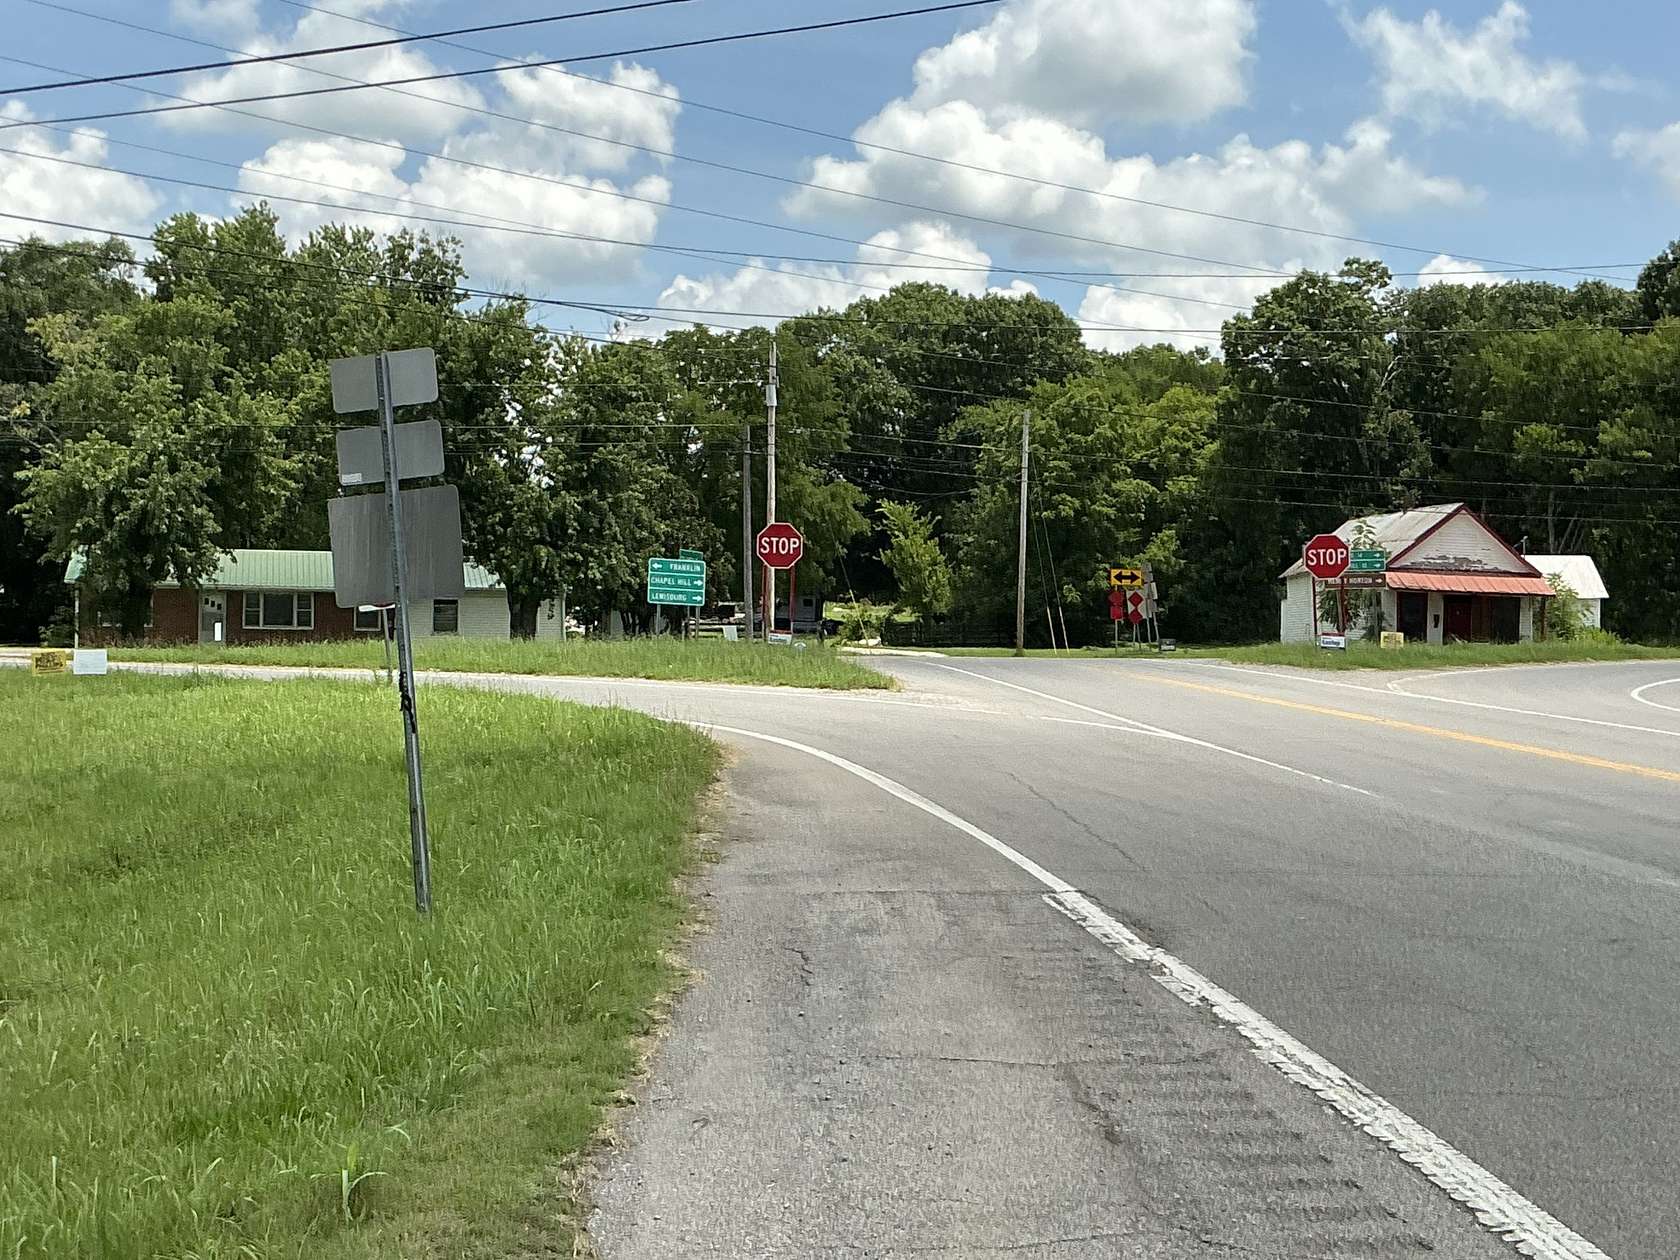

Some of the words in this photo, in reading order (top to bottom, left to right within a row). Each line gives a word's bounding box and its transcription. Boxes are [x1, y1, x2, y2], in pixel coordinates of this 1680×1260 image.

[760, 537, 800, 554] STOP
[1307, 548, 1347, 566] STOP
[669, 563, 701, 572] FRANKLIN
[651, 576, 675, 585] CHAPEL
[677, 578, 691, 586] HILL
[651, 592, 687, 601] LEWISBURG
